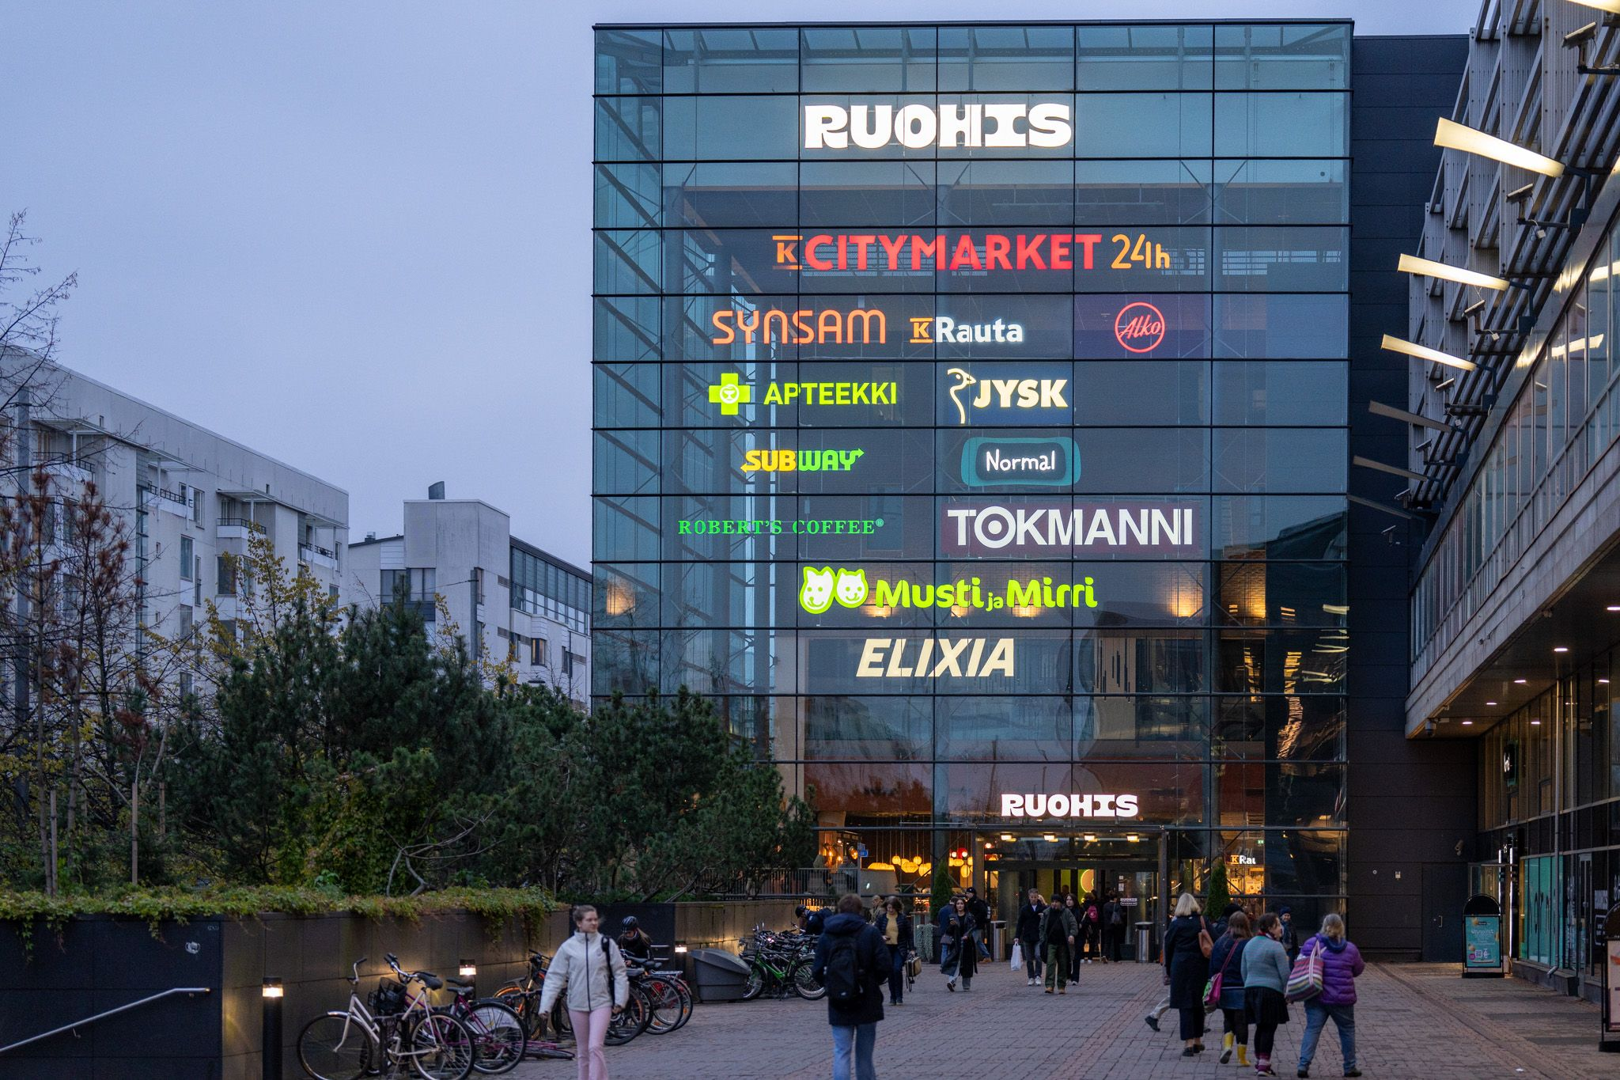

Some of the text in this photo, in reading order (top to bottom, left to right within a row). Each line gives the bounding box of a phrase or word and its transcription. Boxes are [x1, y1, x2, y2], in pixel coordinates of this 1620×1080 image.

[804, 103, 1072, 150] RUOHIS
[804, 233, 1103, 271] CITYMARKET
[1111, 233, 1171, 270] 24h
[711, 309, 887, 345] SYNSAM
[935, 316, 1024, 343] Rauta
[1118, 314, 1161, 340] Alko
[763, 382, 898, 405] APTEEKKI
[973, 379, 1069, 409] JYSK
[740, 447, 865, 473] SUBWAY
[984, 449, 1056, 473] Normal
[947, 505, 1193, 549] TOKMANNI
[875, 576, 1098, 612] Musti ja Mirri
[856, 637, 1015, 678] ELIXIA
[1001, 793, 1138, 818] RUOHIS
